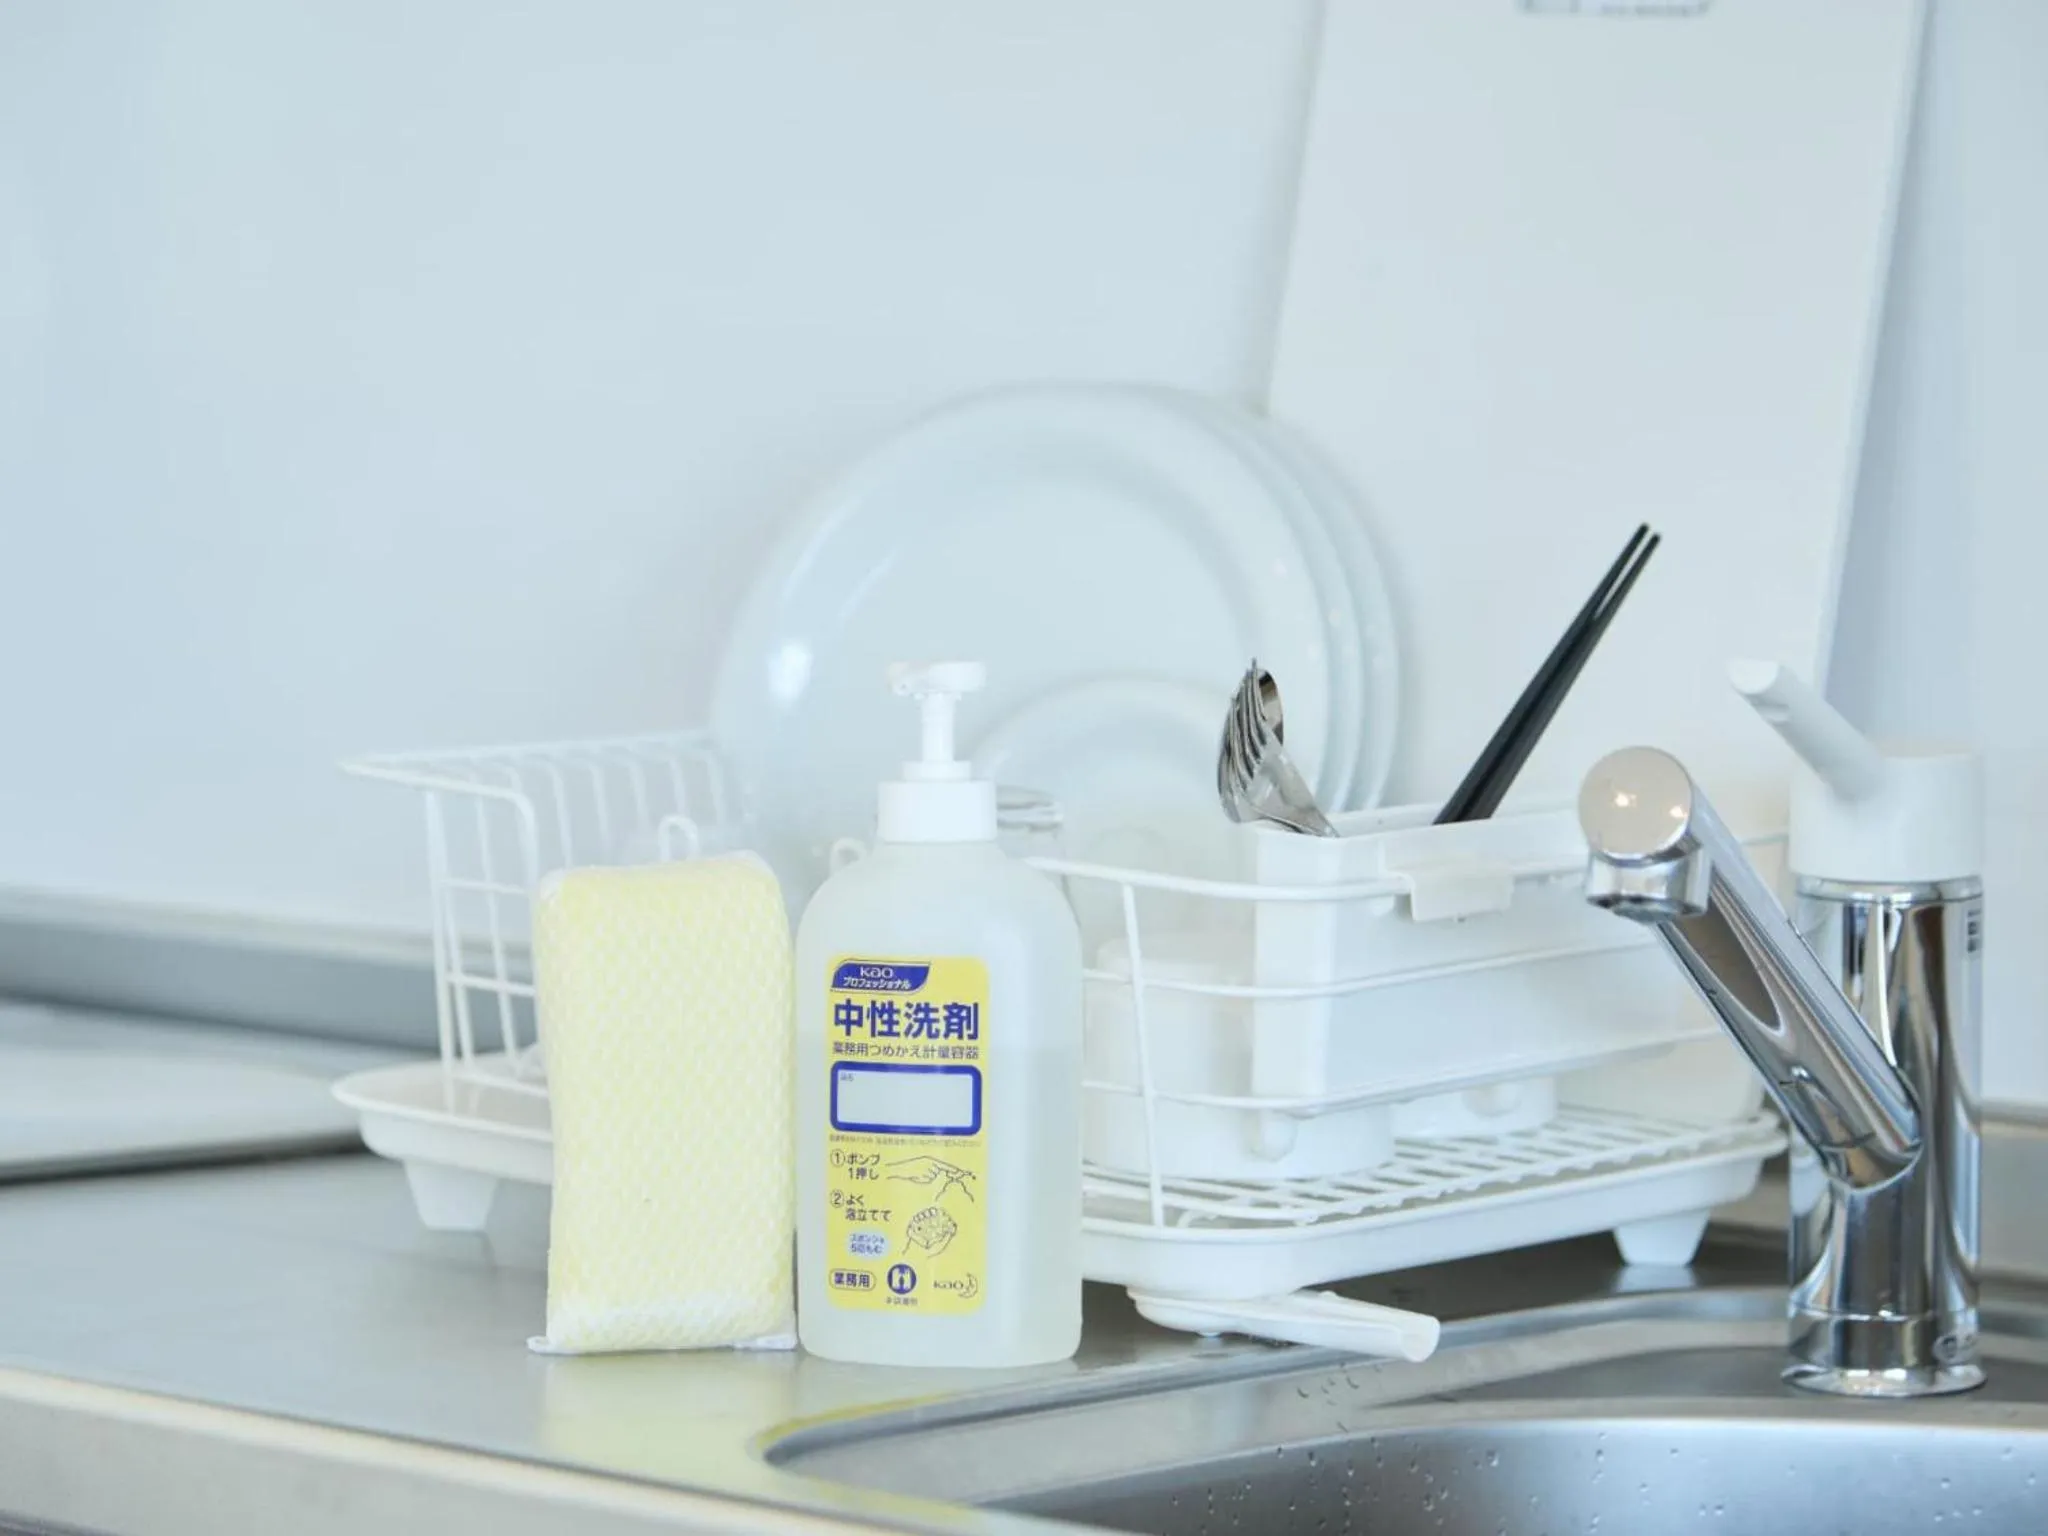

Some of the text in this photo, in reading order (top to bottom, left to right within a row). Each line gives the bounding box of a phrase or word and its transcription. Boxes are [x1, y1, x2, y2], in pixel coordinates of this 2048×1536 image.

[843, 976, 912, 989] プロフェッショナル
[834, 998, 979, 1040] 中性洗剤
[832, 1041, 979, 1060] 業務用つめかえ計量容器
[834, 1272, 870, 1288] 業務用
